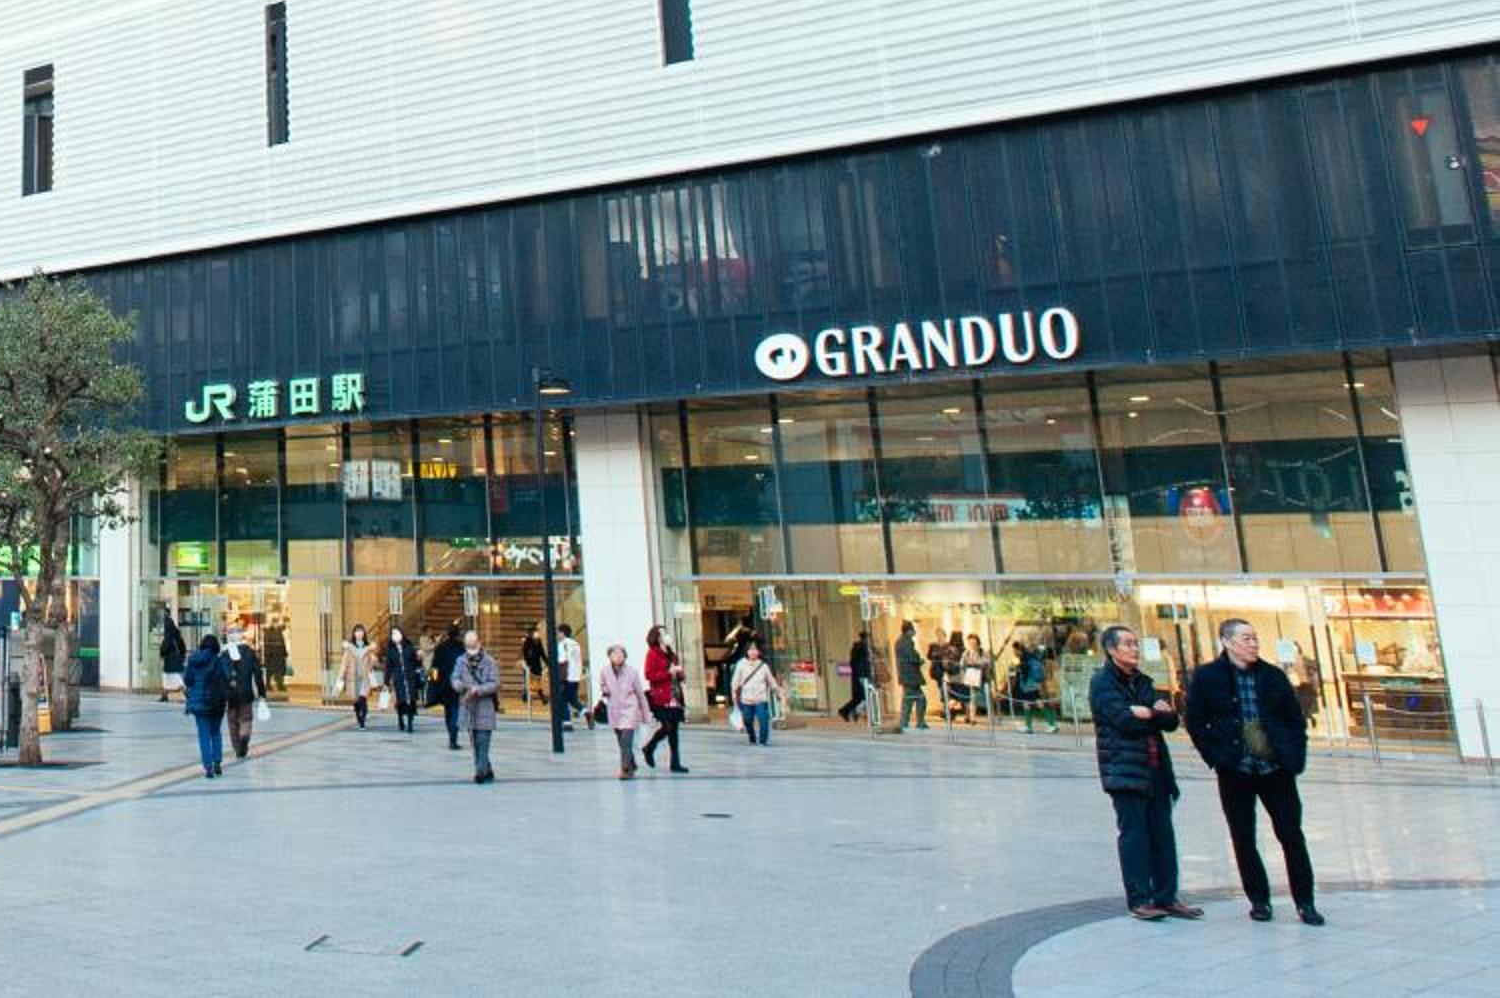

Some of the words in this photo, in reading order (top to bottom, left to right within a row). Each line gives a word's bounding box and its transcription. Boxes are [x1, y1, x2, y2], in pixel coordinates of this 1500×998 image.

[813, 307, 1080, 377] GRANDUO
[185, 383, 237, 423] JR
[247, 373, 367, 418] 蒲田駅
